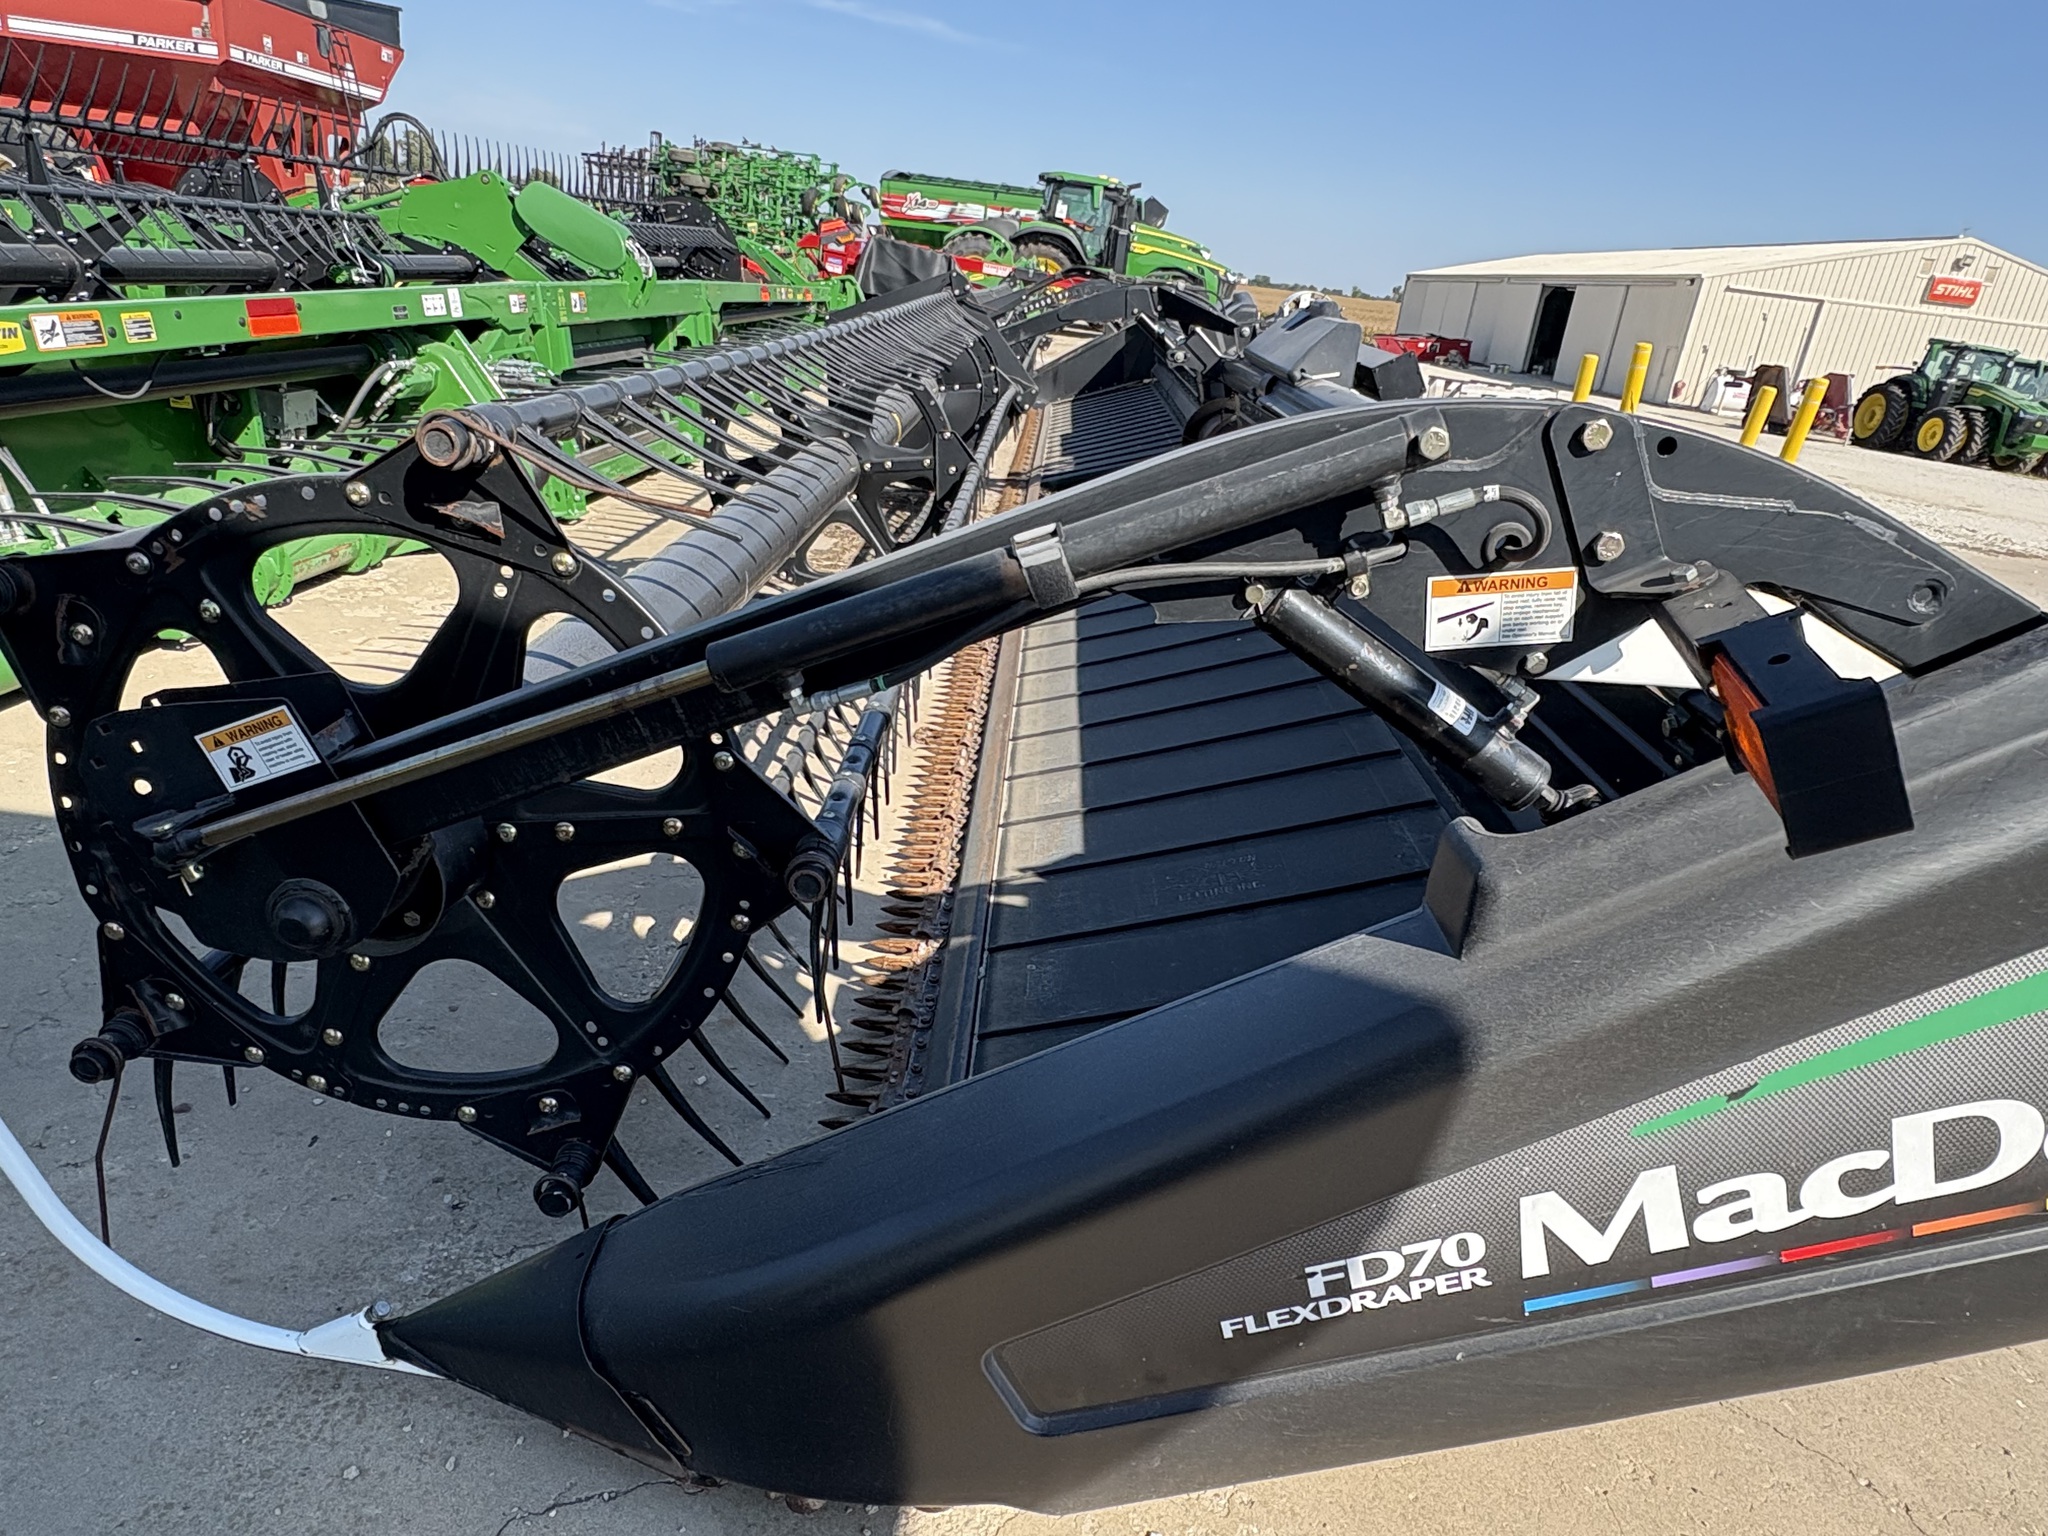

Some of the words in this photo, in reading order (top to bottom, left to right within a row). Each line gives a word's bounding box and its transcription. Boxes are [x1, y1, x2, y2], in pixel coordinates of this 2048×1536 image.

[137, 35, 195, 53] PARKER
[246, 52, 283, 71] PARKER
[1933, 283, 1975, 299] STIHL
[0, 327, 18, 339] IN
[1474, 576, 1549, 593] WARNING
[225, 714, 284, 742] WARNING
[1518, 1098, 2048, 1280] MacD
[1304, 1231, 1487, 1299] FD70
[1219, 1266, 1493, 1340] FLEXDRAPER
